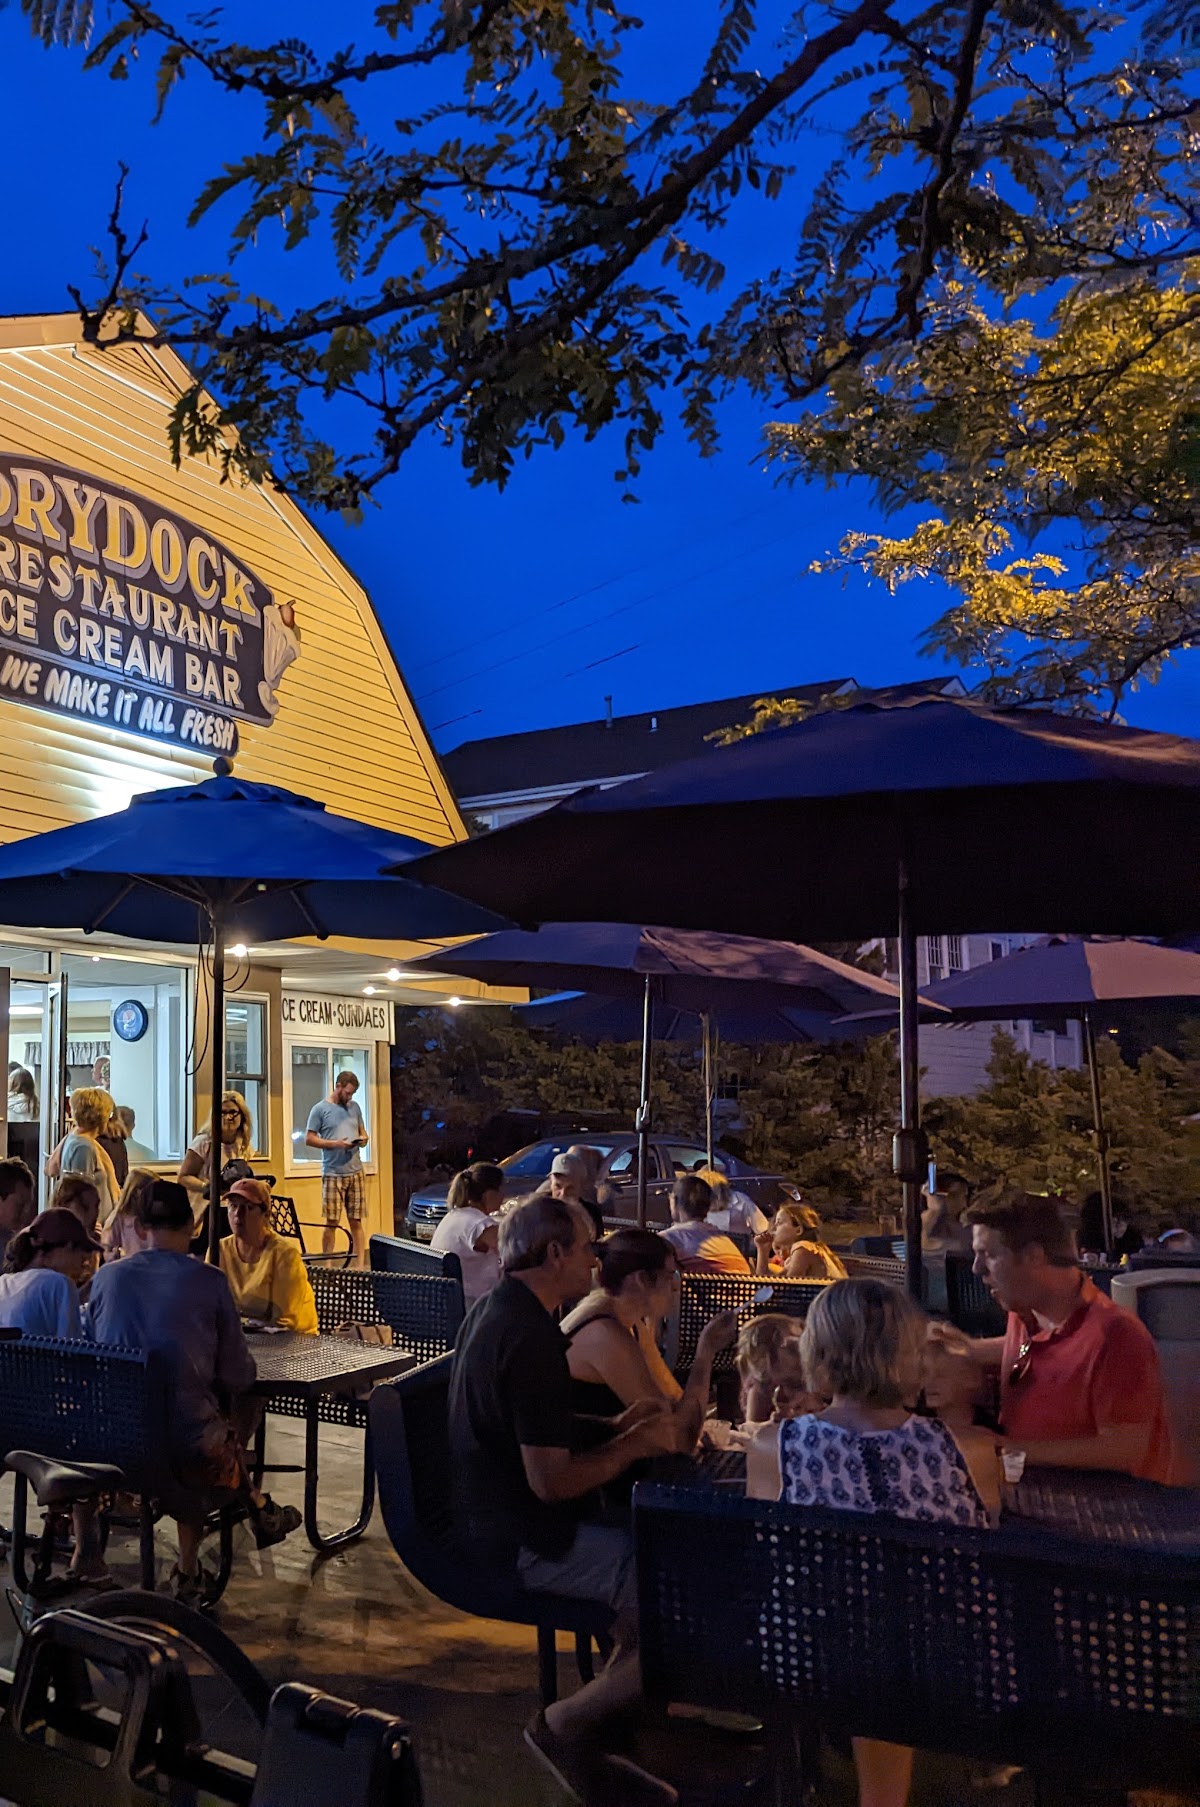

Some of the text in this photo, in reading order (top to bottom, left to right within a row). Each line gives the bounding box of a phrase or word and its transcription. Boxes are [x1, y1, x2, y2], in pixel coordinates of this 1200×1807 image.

[1, 655, 235, 752] WE MAKE IT ALL FRESH
[53, 608, 174, 687] CREAM
[185, 652, 242, 708] BAR
[299, 999, 333, 1025] CREAM
[337, 1003, 386, 1029] SUNDAES
